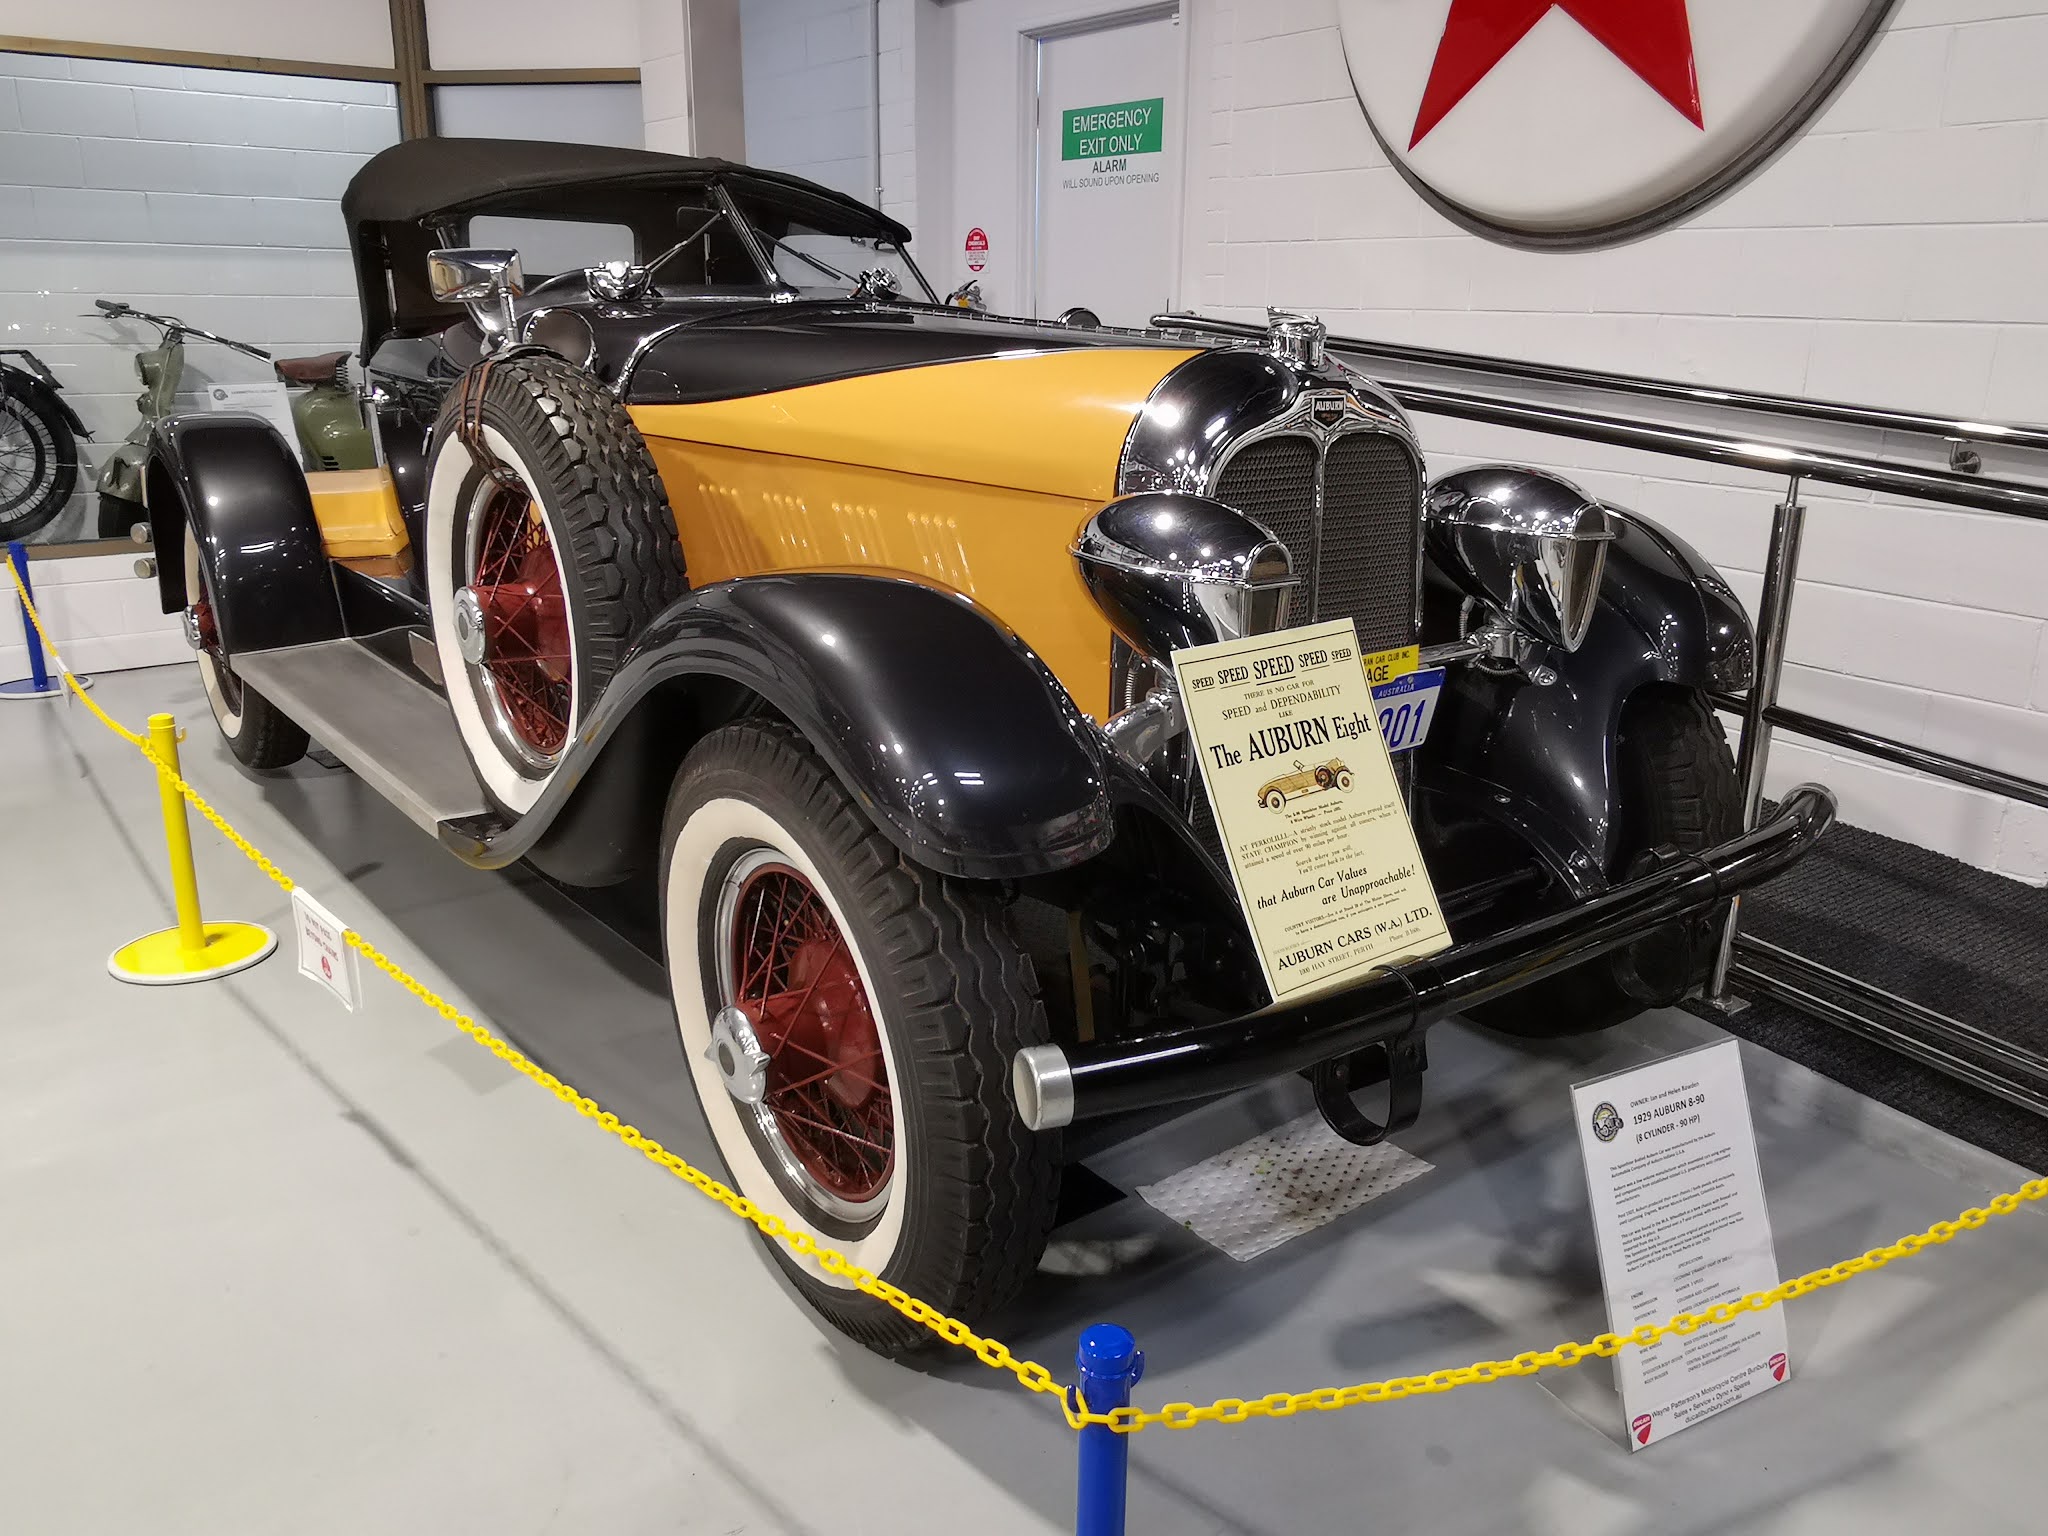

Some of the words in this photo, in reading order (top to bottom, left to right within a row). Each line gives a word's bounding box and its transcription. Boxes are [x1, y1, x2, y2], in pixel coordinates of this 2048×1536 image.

[1072, 107, 1152, 133] EMERGENCY
[1080, 137, 1106, 156] EXIT
[1109, 134, 1142, 152] ONLY
[1092, 158, 1127, 174] ALARM
[1063, 178, 1078, 189] WILL
[1079, 176, 1103, 188] SOUND
[1105, 175, 1124, 186] UPON
[1126, 172, 1160, 184] OPENING
[1315, 400, 1344, 411] AUBURN
[1192, 677, 1214, 689] SPEED
[1218, 666, 1249, 685] SPEED
[1253, 655, 1294, 680] SPEED
[1298, 650, 1328, 668] SPEED
[1331, 648, 1352, 660] SPEED
[1376, 655, 1386, 664] CAR
[1388, 652, 1400, 662] CLUB
[1222, 706, 1251, 720] SPEED
[1255, 702, 1268, 713] and
[1270, 685, 1340, 709] DEPENDABILITY
[1244, 690, 1263, 700] THERE
[1378, 684, 1415, 698] AUSTRALIA
[1279, 710, 1293, 718] LIKE
[1210, 744, 1242, 769] The
[1250, 716, 1330, 762] AUBURN
[1332, 712, 1372, 740] Eight
[1242, 850, 1260, 860] STATE
[1265, 839, 1298, 853] CHAMPION
[1296, 858, 1312, 867] Search
[1315, 853, 1329, 861] where
[1328, 858, 1338, 866] back
[1258, 895, 1277, 909] that
[1282, 885, 1315, 902] Auburn
[1318, 877, 1334, 889] Car
[1337, 868, 1367, 882] Values
[1322, 895, 1336, 905] are
[1341, 864, 1415, 898] Unapproachable!
[1279, 940, 1334, 971] AUBURN
[1338, 927, 1372, 947] CARS
[1375, 918, 1402, 935] (W.A.)
[1405, 907, 1432, 924] LTD.
[1312, 961, 1325, 971] HAY
[1354, 943, 1374, 955] PERTH
[1630, 1098, 1649, 1108] OWNER:
[1659, 1091, 1667, 1099] and
[1634, 1111, 1652, 1125] 1929
[1654, 1100, 1687, 1118] AUBURN
[1688, 1094, 1705, 1107] 8-90
[1636, 1134, 1643, 1144] (8
[1644, 1123, 1675, 1140] CYLINDER
[1680, 1119, 1688, 1128] 90
[1689, 1114, 1700, 1125] HP)
[1652, 1407, 1670, 1418] Wayne
[1701, 1380, 1729, 1396] Motorcycle
[1730, 1372, 1747, 1383] Centre
[1748, 1363, 1768, 1375] Bunbury
[1674, 1409, 1688, 1419] Sales
[1693, 1399, 1711, 1411] Service
[1734, 1380, 1751, 1392] Spares
